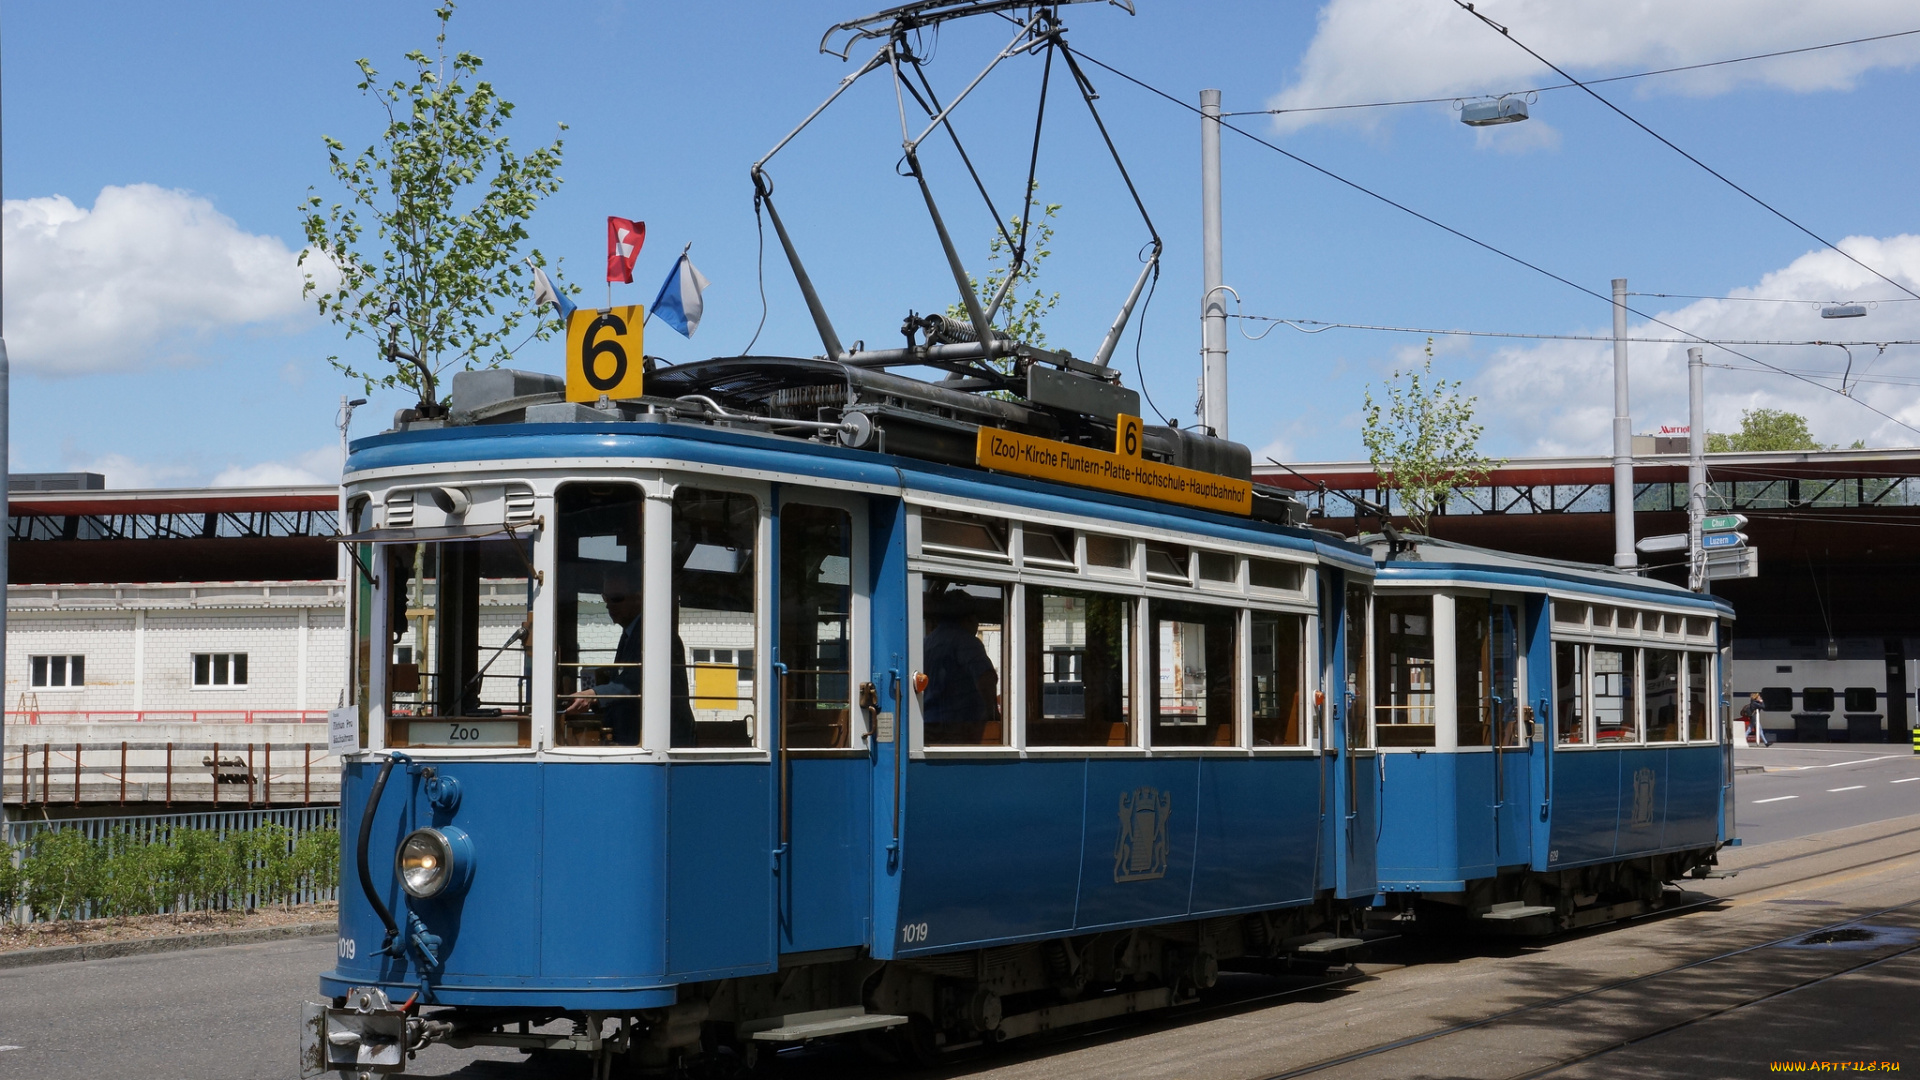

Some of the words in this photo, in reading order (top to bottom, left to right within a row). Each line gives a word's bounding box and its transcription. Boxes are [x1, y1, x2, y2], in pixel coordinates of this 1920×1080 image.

[582, 314, 627, 391] 6
[1125, 421, 1137, 456] 6
[1658, 425, 1690, 434] Marriot
[990, 435, 1058, 467] (Zoo)-Kirche
[1060, 452, 1245, 504] Fluntern-Platte-Hochschule-Hauptbahnhof
[1711, 518, 1726, 528] Chur
[1709, 536, 1729, 545] Luzern
[449, 723, 480, 741] Zoo
[903, 922, 928, 943] 1019
[338, 937, 356, 960] 1019
